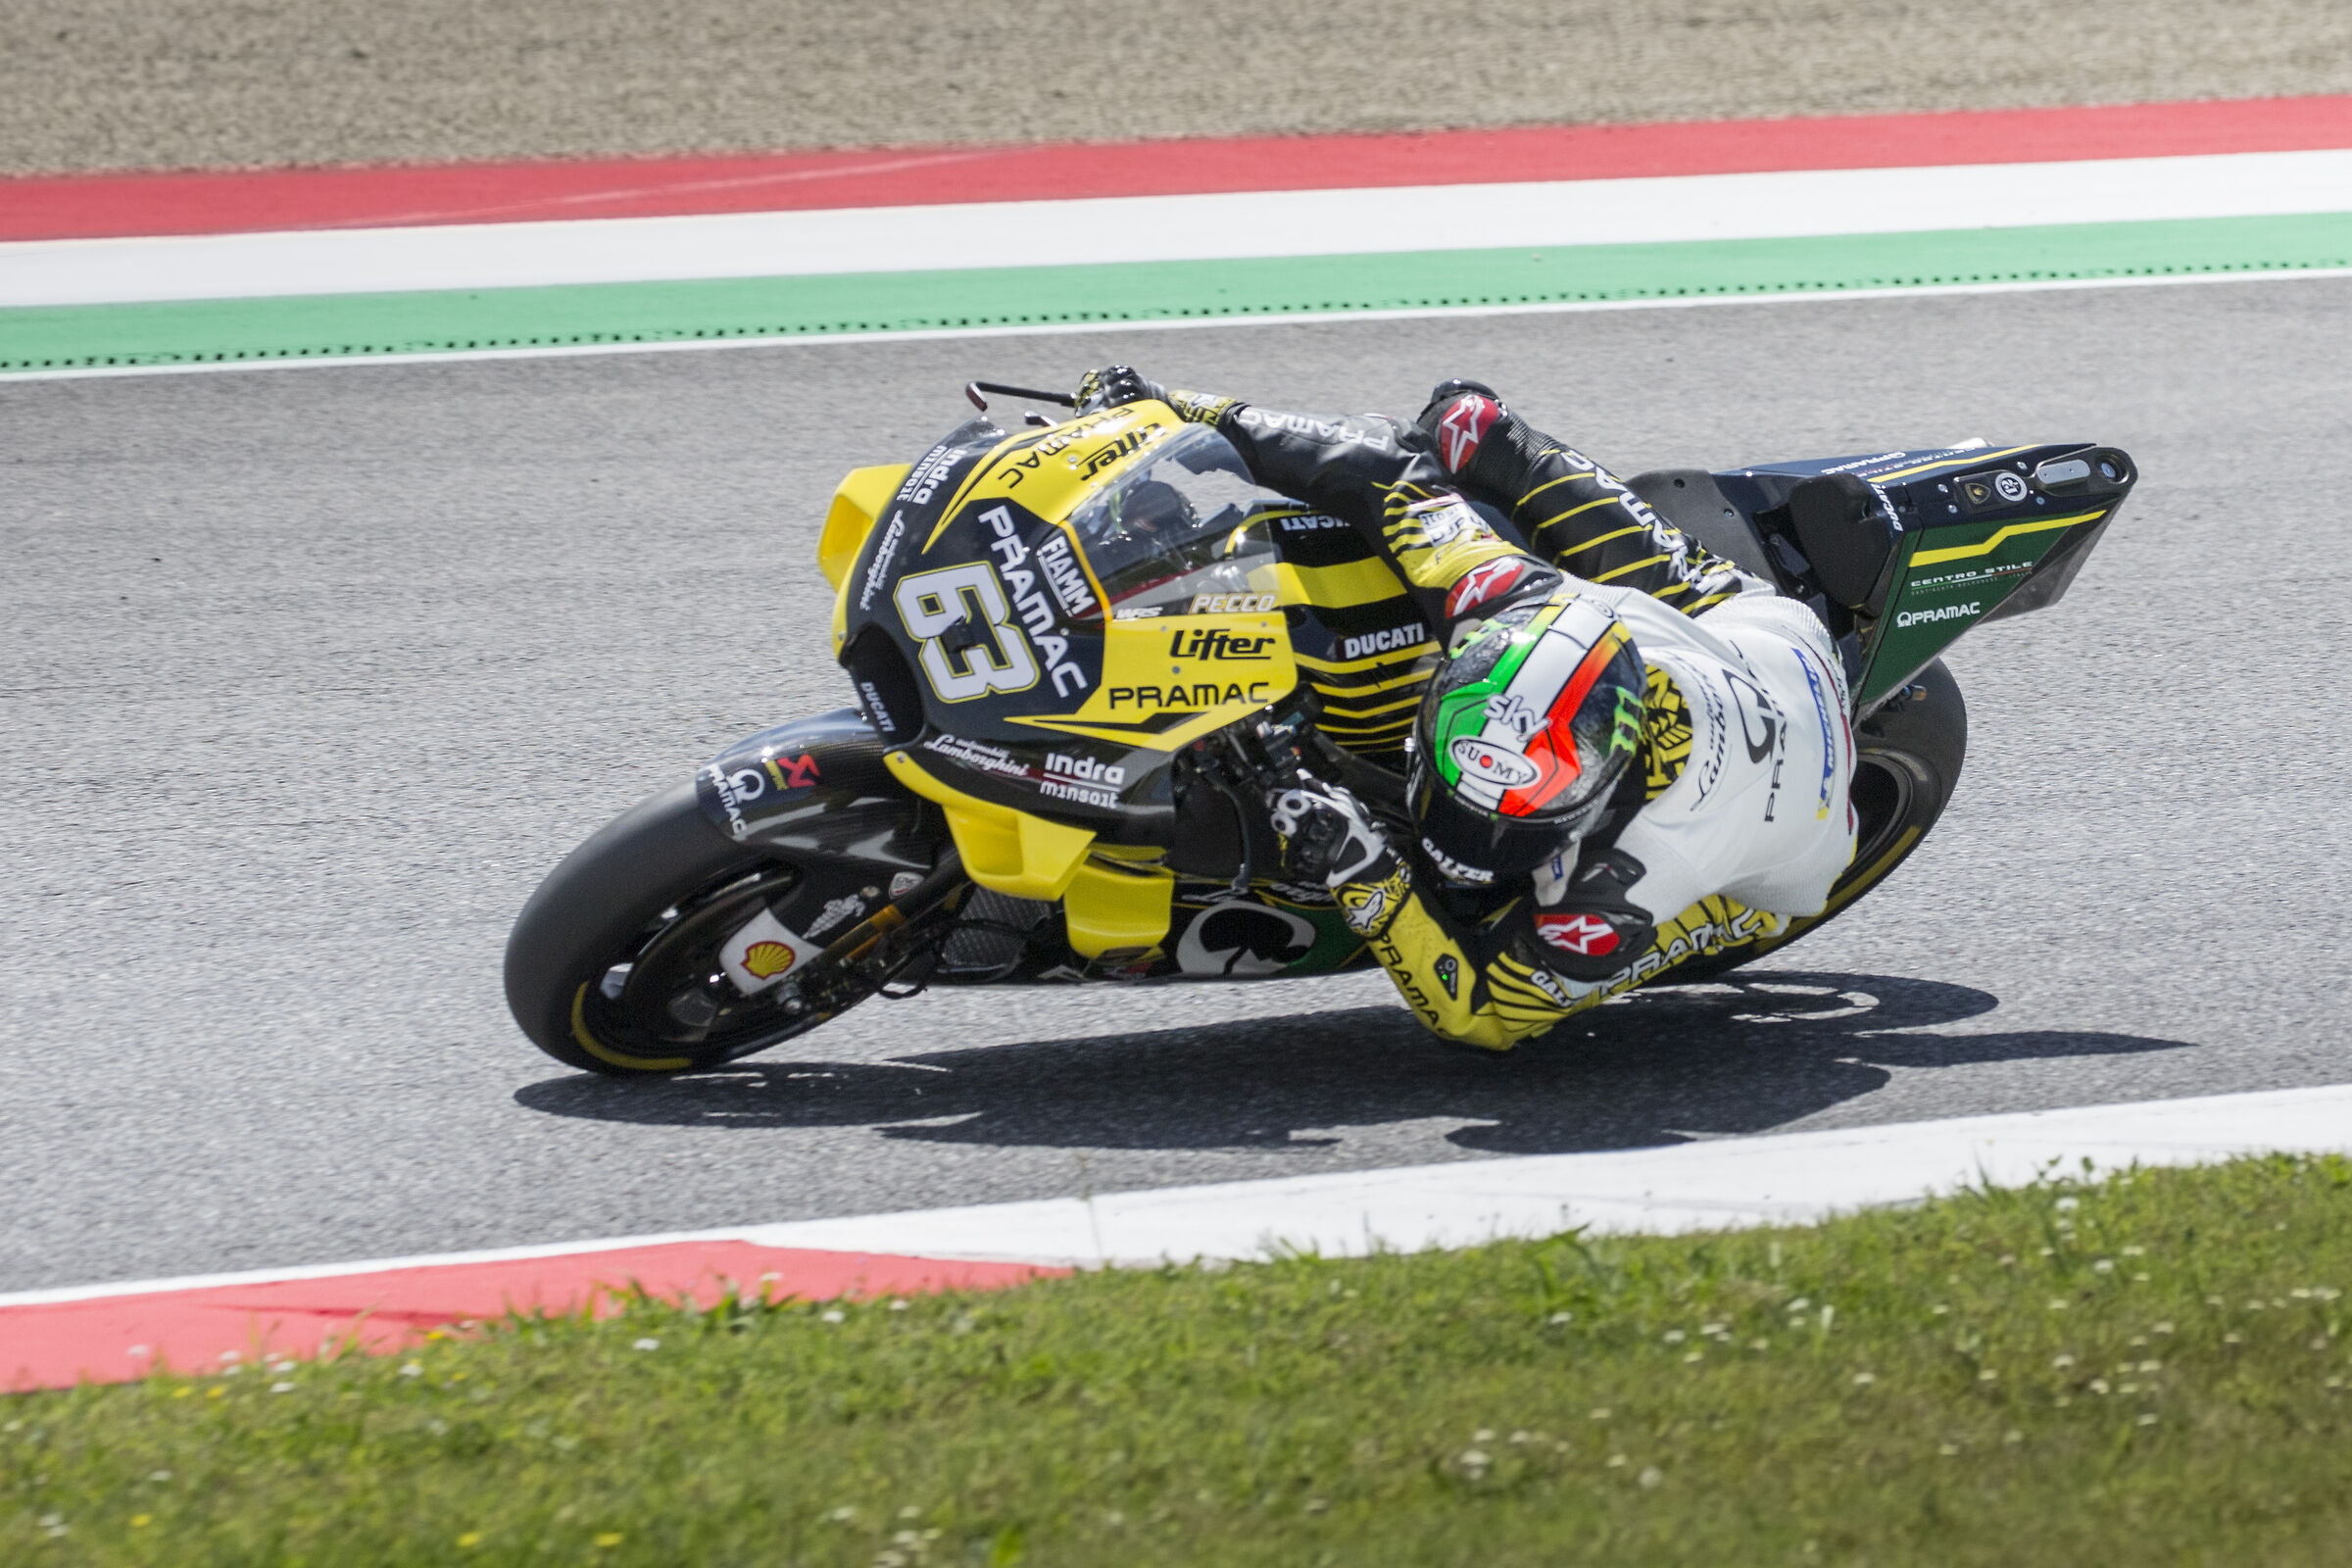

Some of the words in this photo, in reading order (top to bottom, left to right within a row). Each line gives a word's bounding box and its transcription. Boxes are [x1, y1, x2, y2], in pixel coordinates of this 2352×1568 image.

[1238, 407, 1390, 452] PRAMAC
[1871, 483, 1903, 532] DUCATI
[1042, 535, 1096, 614] FIAMM
[1911, 571, 1977, 587] CENTRO
[1984, 561, 2034, 573] STILE
[977, 505, 1088, 699] PRAMAC
[1189, 593, 1277, 614] PECCO
[1912, 602, 1981, 625] PRAMAC
[894, 561, 1041, 703] 63
[1169, 628, 1276, 661] Lifter
[1345, 623, 1425, 660] DUCATI
[860, 682, 897, 733] DUCATI
[1108, 682, 1269, 710] PRAMAC
[1483, 693, 1552, 742] sky
[923, 734, 1030, 777] Lamborghini
[706, 764, 748, 834] PRAMAC
[1380, 933, 1445, 1032] PRAMA
